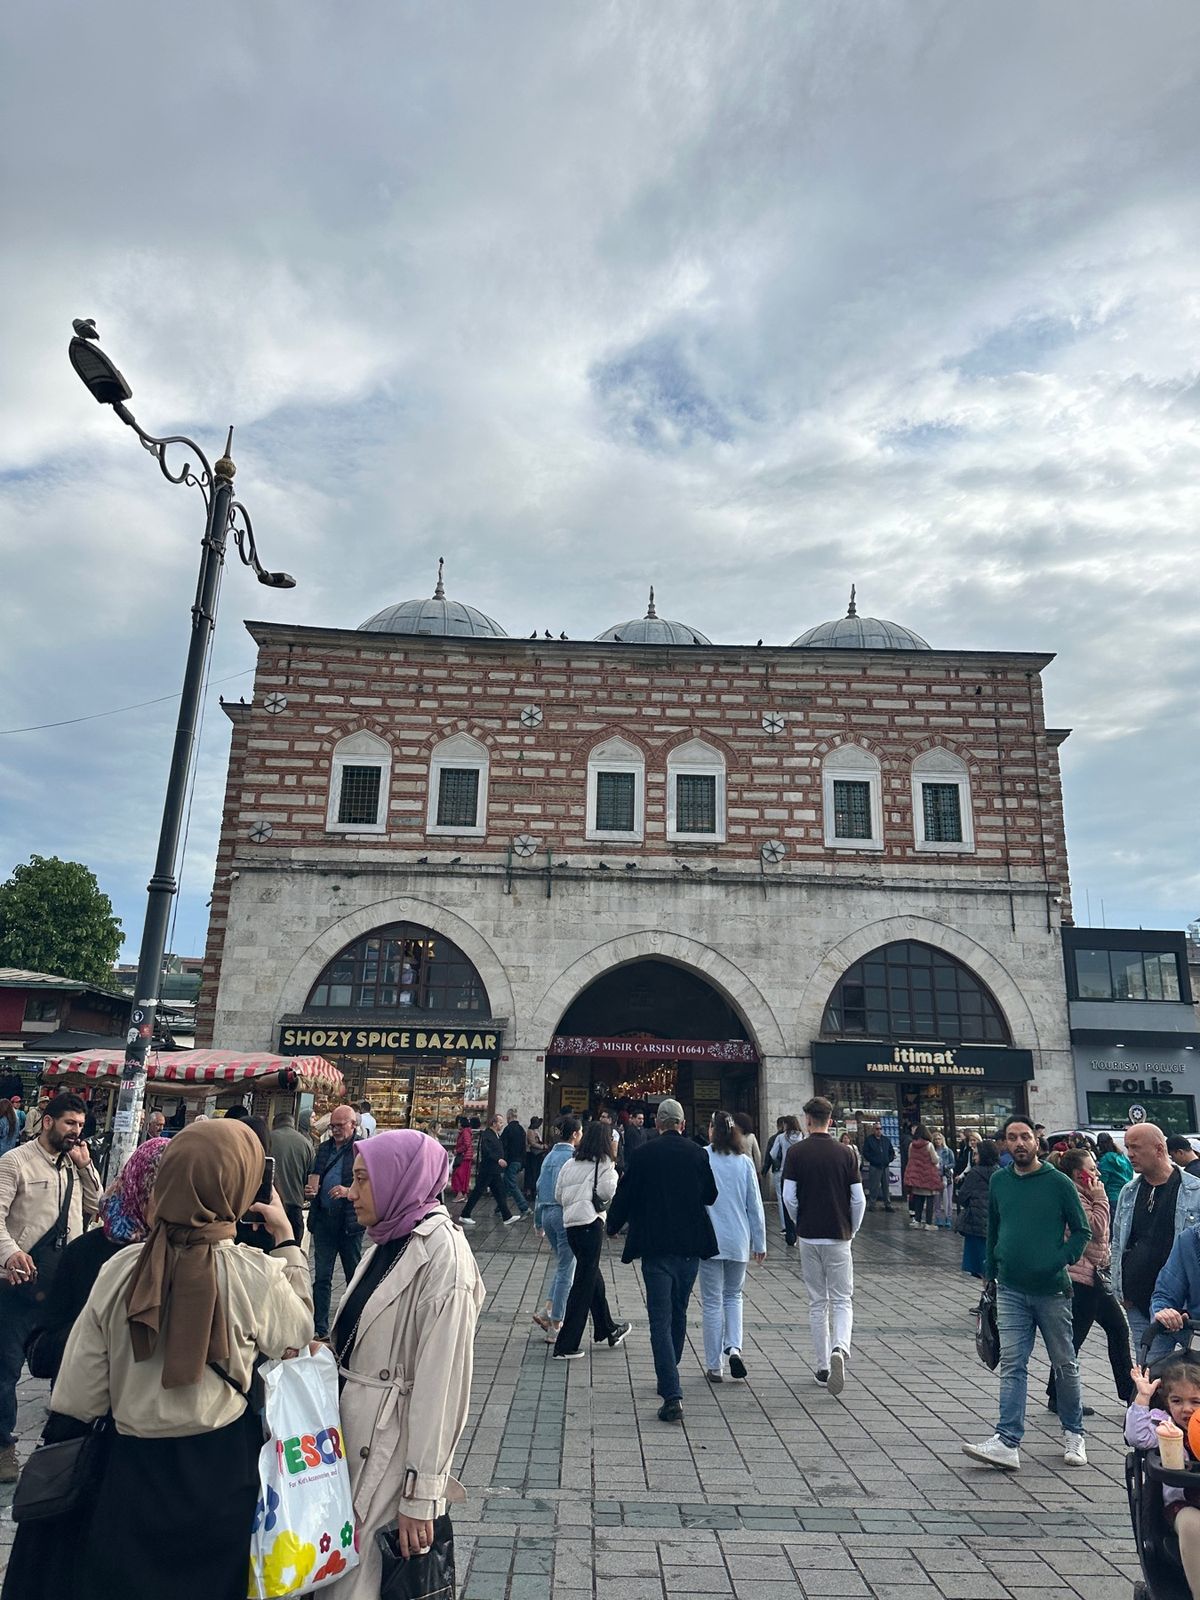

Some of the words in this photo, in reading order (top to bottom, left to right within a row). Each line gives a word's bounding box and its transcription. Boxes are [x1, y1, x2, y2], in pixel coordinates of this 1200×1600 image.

[283, 1030, 352, 1048] SHOZY
[356, 1031, 410, 1048] SPICE
[415, 1032, 497, 1050] BAZAAR
[602, 1042, 632, 1052] MISIR
[634, 1043, 676, 1055] ÇARŞISI
[677, 1044, 705, 1056] (1664)
[893, 1047, 954, 1065] itimat
[867, 1063, 905, 1073] FABRİKA
[909, 1064, 935, 1076] SATIŞ
[939, 1064, 985, 1076] MAĞAZASI
[1091, 1060, 1139, 1073] TOURISM
[1145, 1063, 1186, 1073] POLICE
[1108, 1077, 1174, 1094] POLİS
